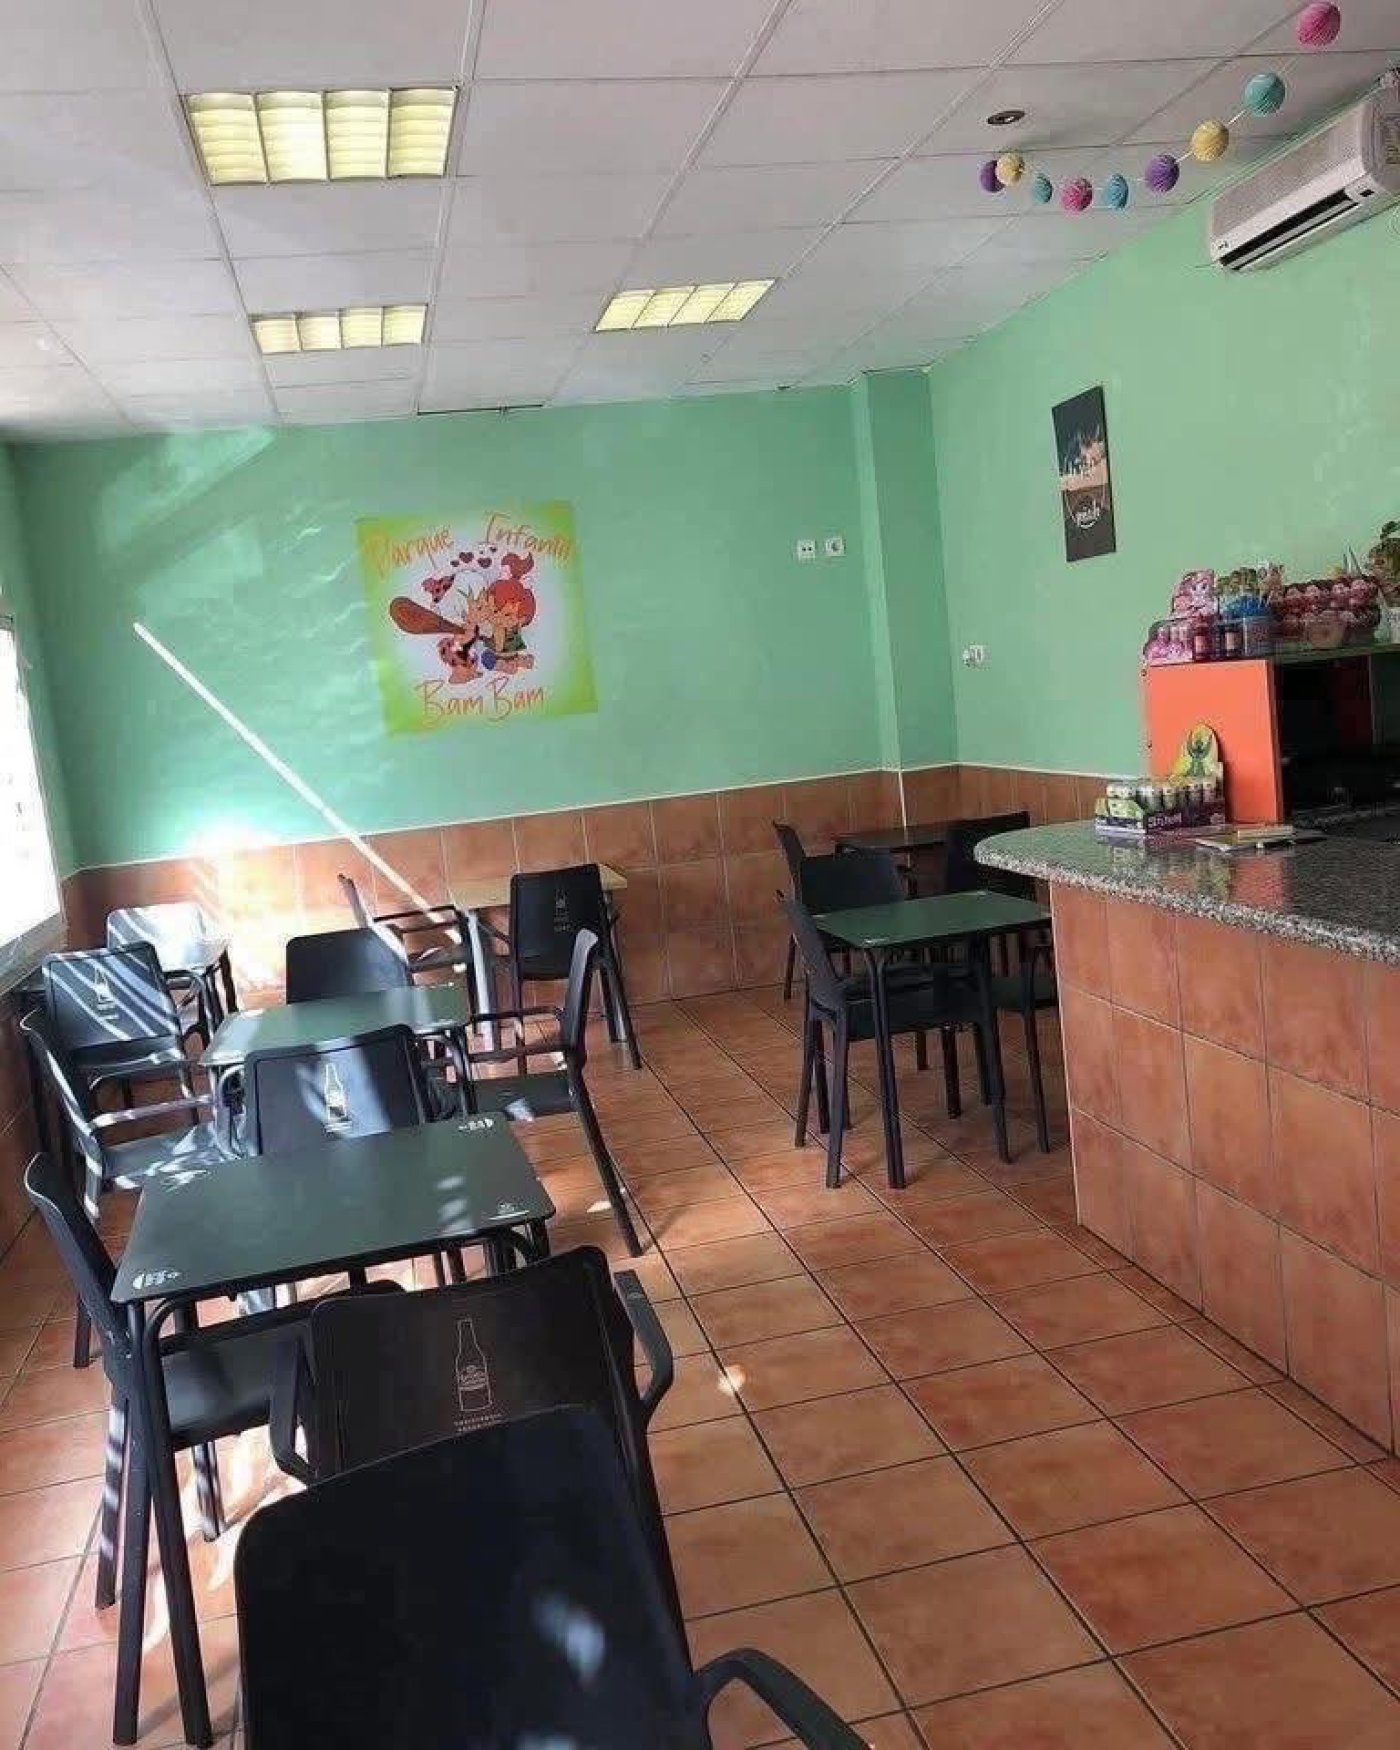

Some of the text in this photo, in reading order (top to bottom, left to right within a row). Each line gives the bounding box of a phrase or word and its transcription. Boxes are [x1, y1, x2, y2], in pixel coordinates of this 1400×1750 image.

[367, 526, 454, 576] Parque
[415, 676, 545, 724] Bam Bam
